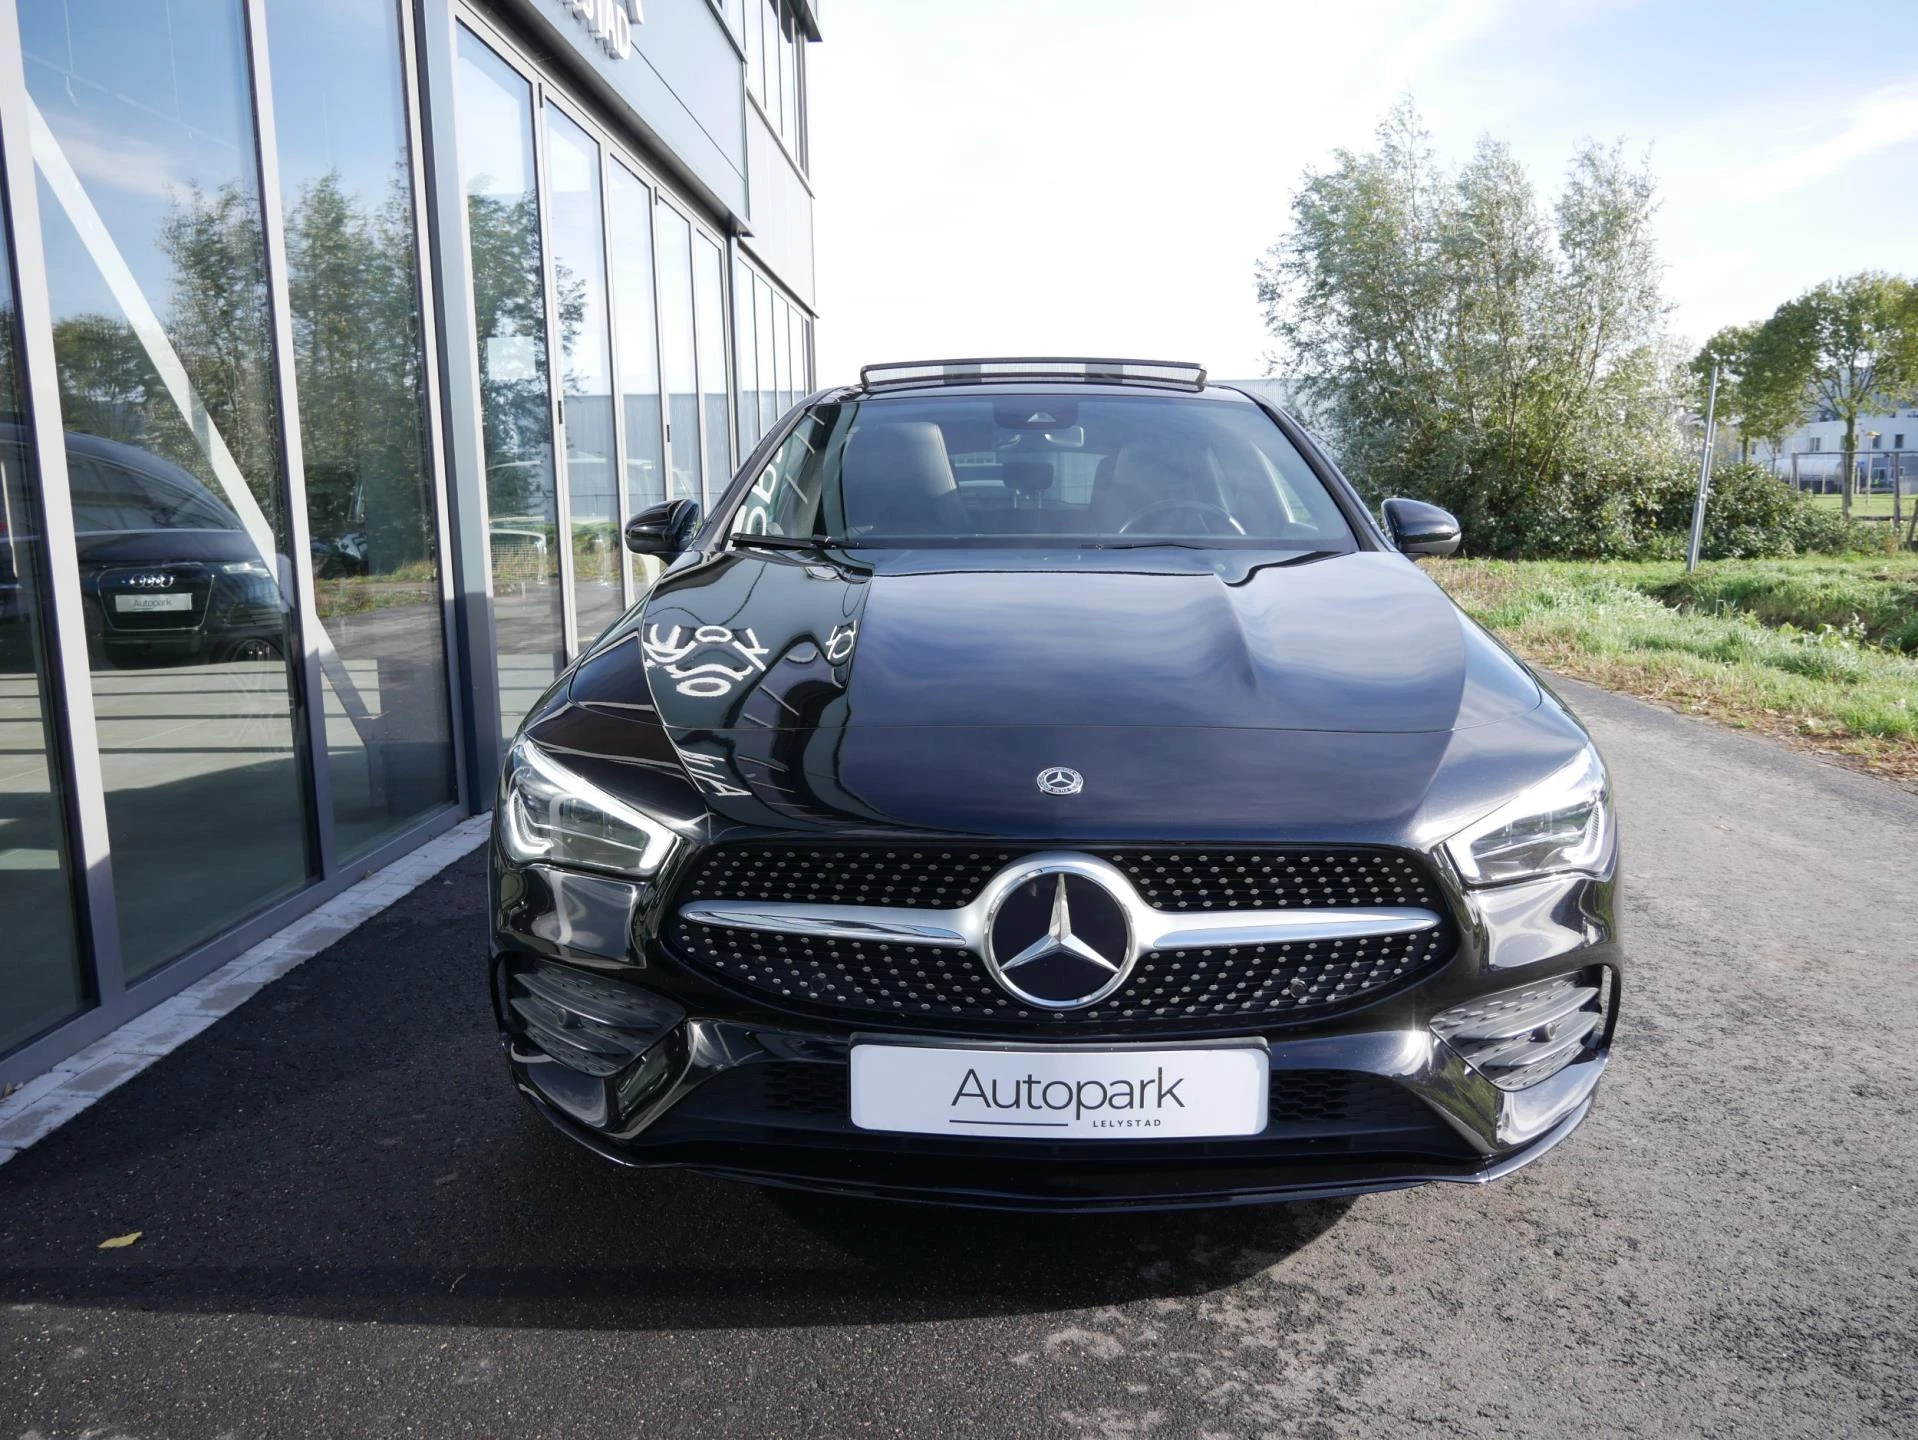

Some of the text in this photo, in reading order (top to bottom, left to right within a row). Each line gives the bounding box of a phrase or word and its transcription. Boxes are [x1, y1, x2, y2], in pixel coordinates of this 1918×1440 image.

[133, 598, 173, 608] Autopark
[951, 1066, 1186, 1121] Autopark
[1092, 1119, 1162, 1128] LELYSTAD
